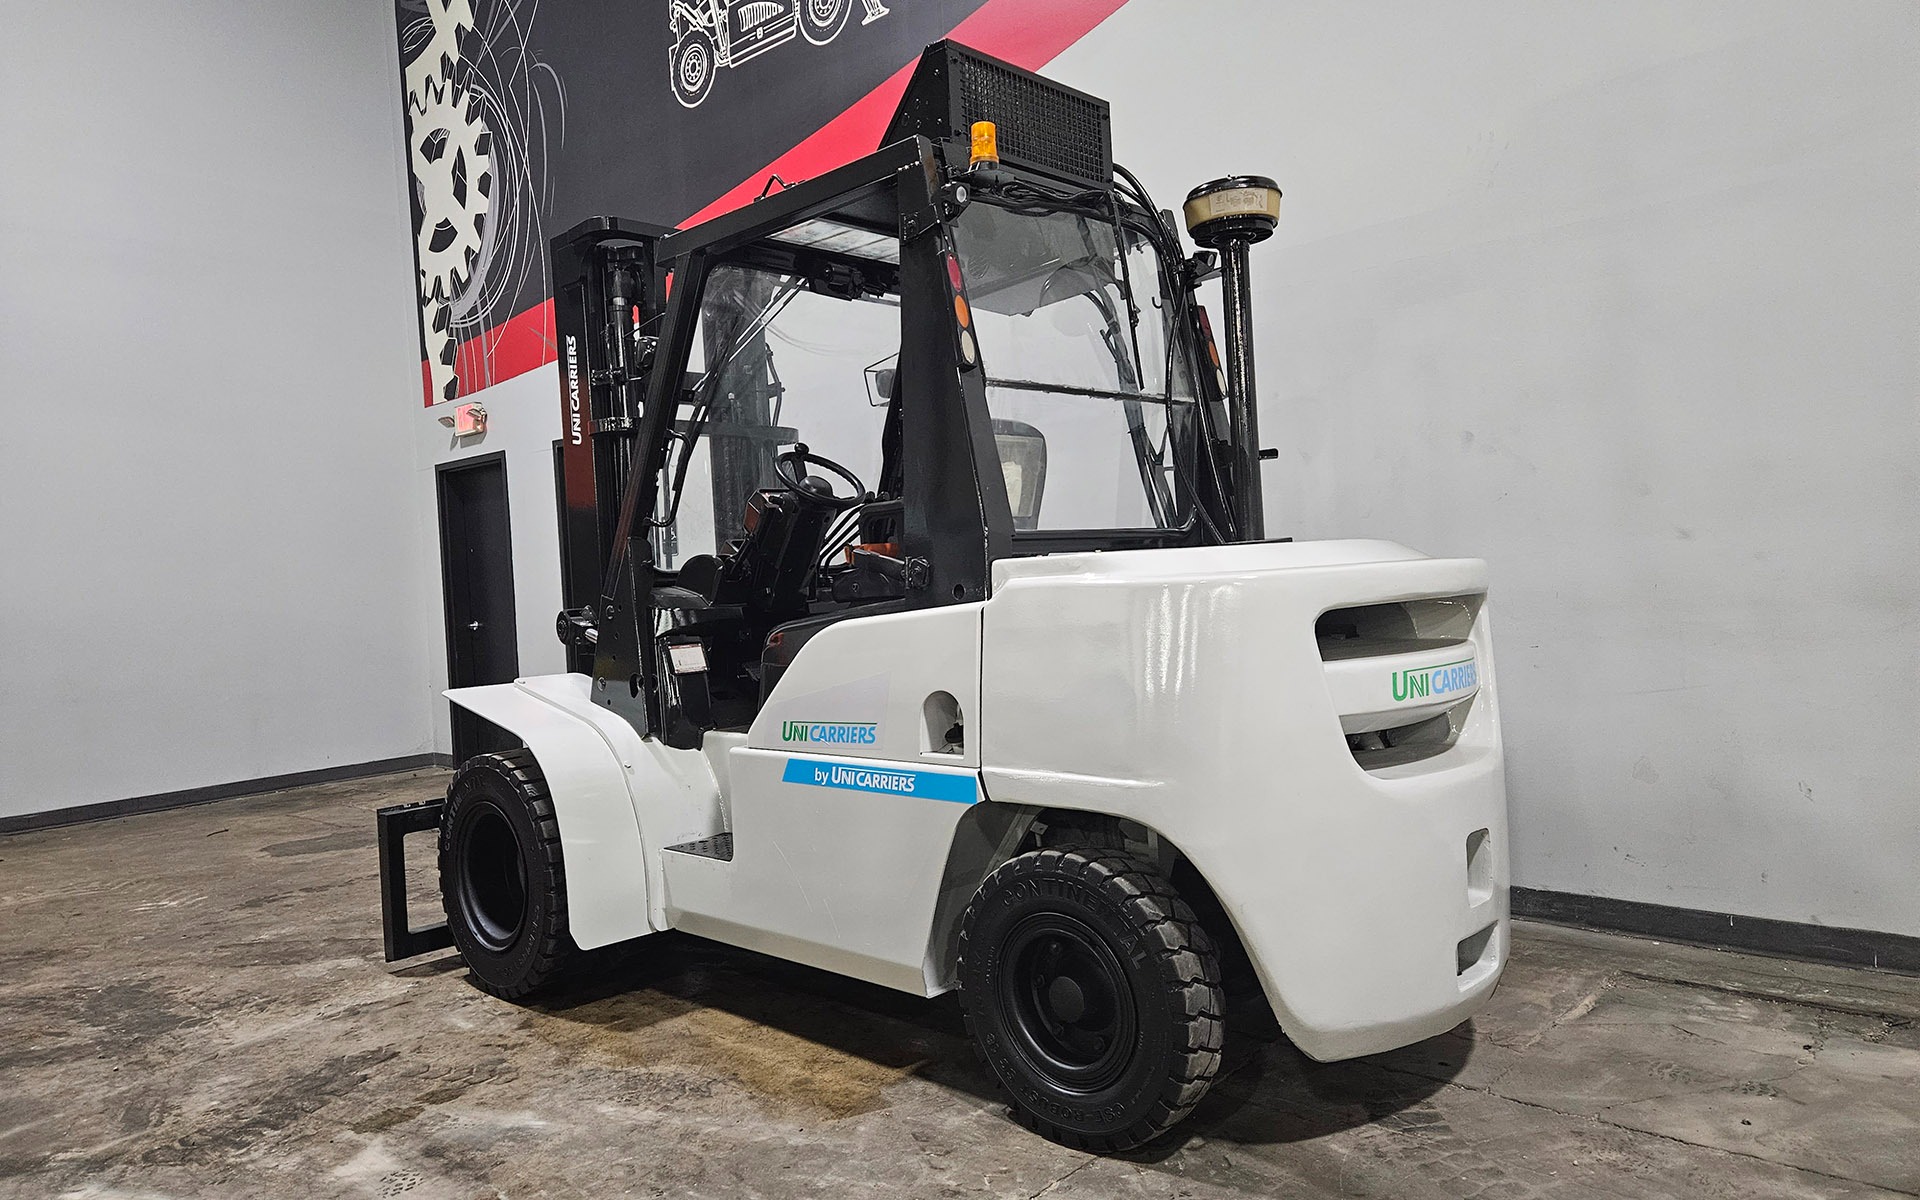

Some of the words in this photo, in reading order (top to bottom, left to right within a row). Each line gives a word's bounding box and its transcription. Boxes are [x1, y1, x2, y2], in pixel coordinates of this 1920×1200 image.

[566, 334, 582, 445] UNICARRIERS
[782, 720, 878, 744] UNICARRIERS
[814, 768, 829, 786] by
[831, 766, 916, 793] UNICARRIERS
